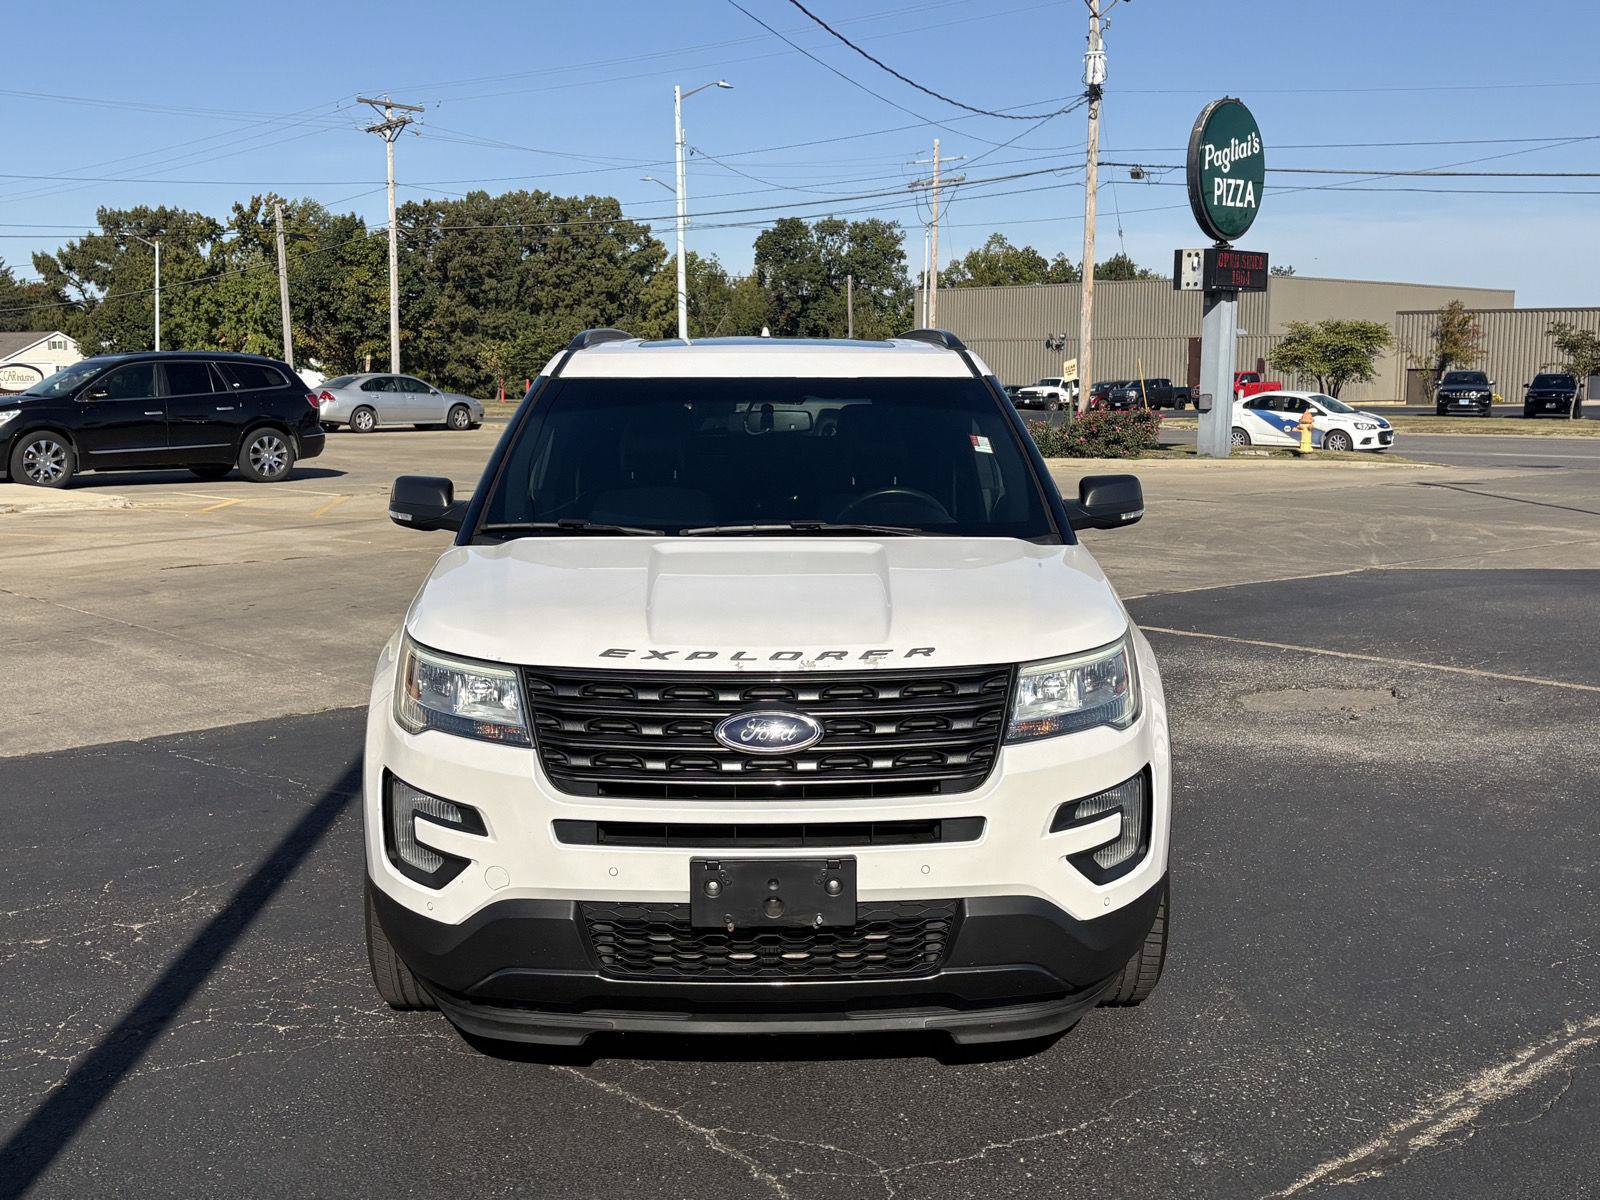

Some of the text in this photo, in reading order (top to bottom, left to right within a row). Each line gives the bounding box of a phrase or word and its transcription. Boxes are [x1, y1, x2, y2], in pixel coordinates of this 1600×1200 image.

[1204, 132, 1260, 173] Pagliai's
[1213, 177, 1256, 208] PIZZA
[598, 646, 936, 662] EXPLORER
[740, 718, 800, 742] Ford
